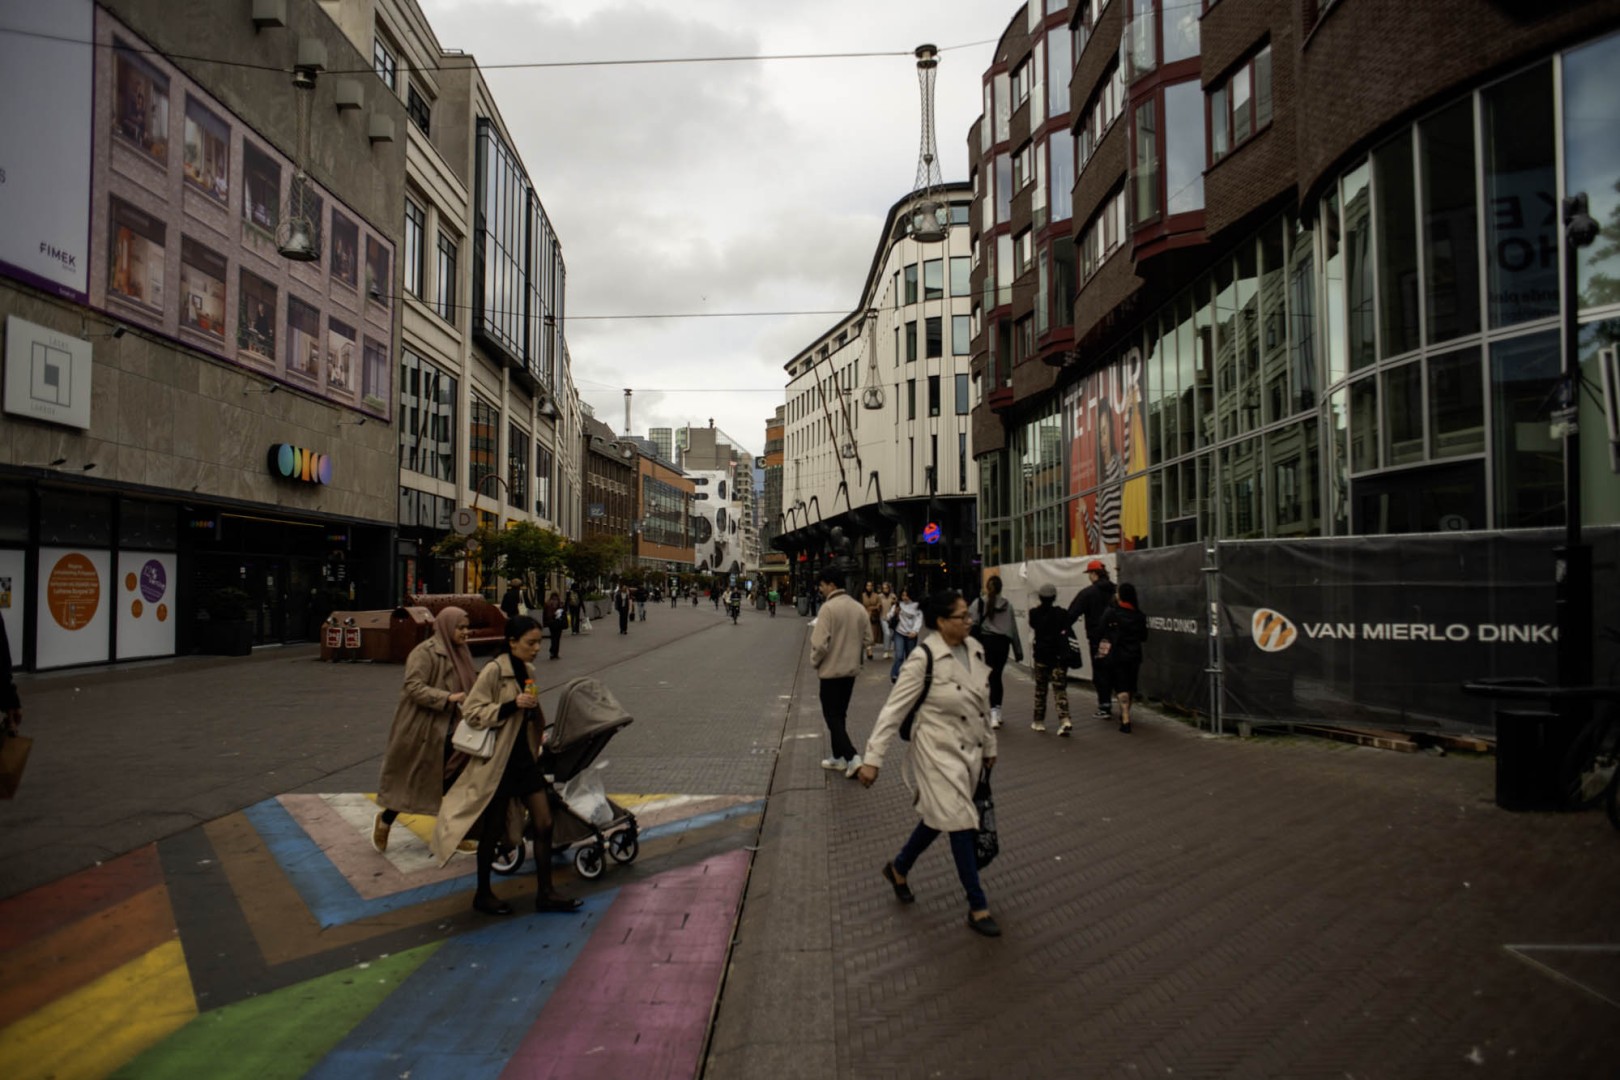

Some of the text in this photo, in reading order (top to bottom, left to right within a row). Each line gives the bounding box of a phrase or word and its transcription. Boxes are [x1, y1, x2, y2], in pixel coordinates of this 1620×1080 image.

[40, 242, 76, 267] FIMEK
[459, 512, 471, 526] D
[1302, 622, 1355, 639] VAN
[1362, 623, 1470, 641] MIERLO
